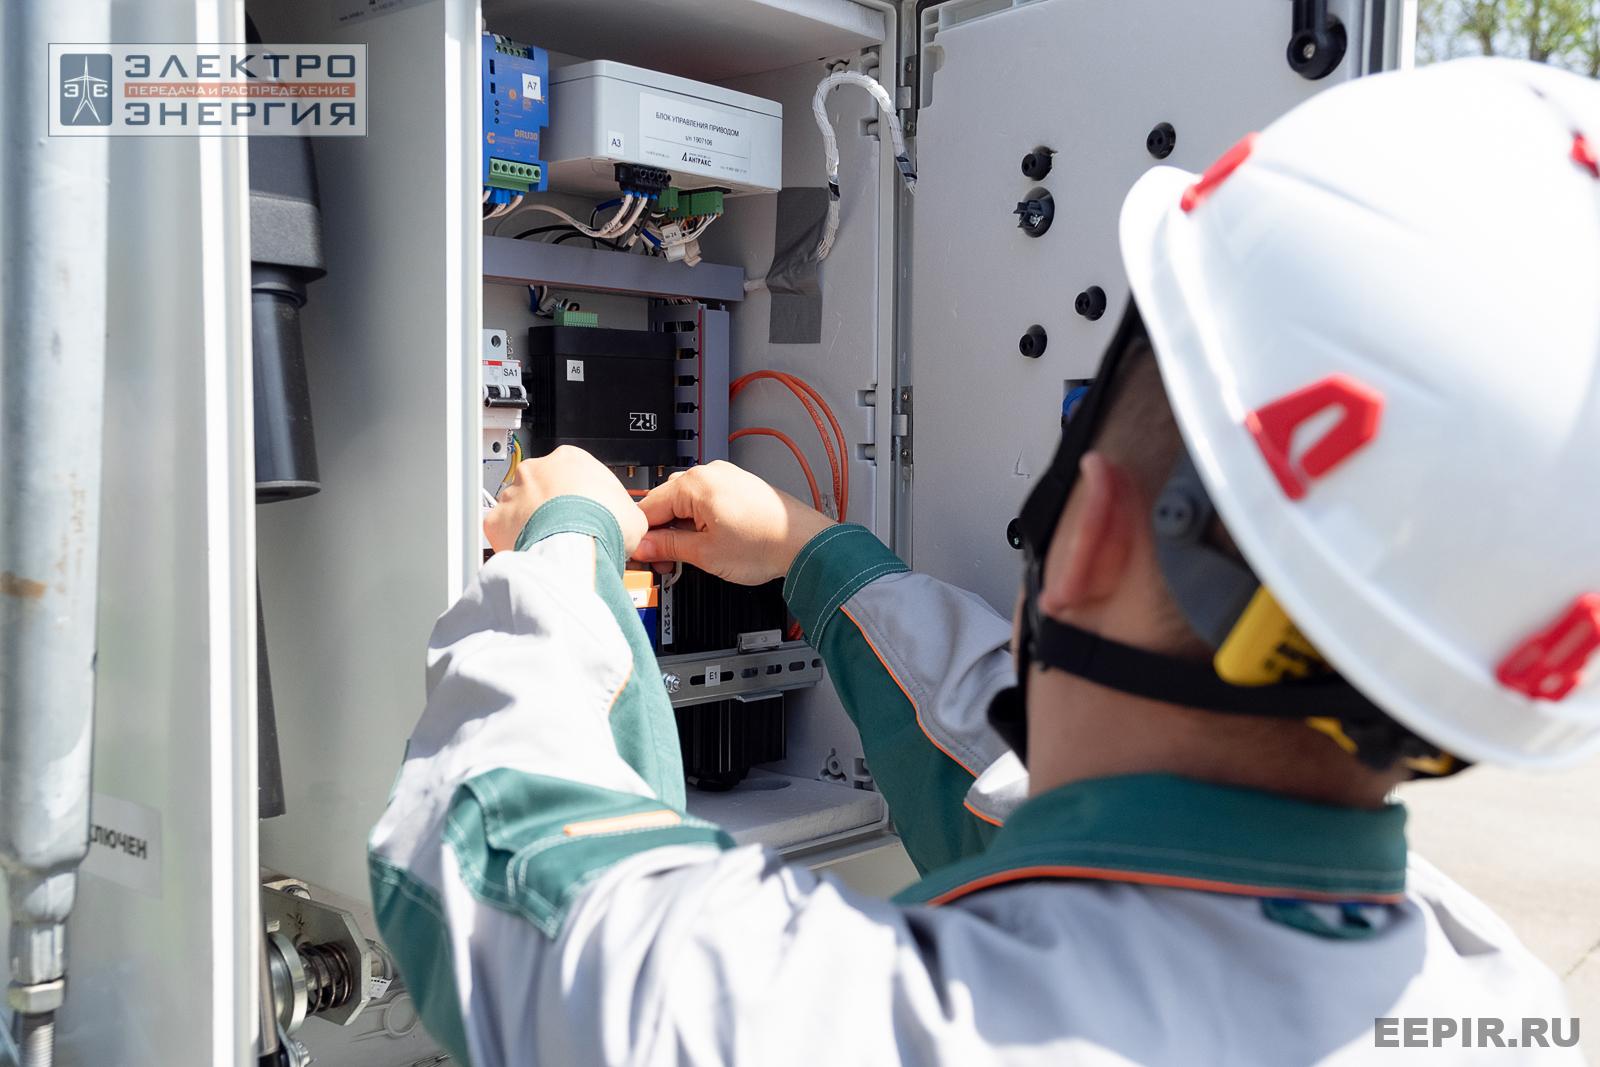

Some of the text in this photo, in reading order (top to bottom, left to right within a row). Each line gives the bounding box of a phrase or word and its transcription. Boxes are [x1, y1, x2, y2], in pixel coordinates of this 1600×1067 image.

[655, 111, 740, 137] БЛОК УПРАВЛЕНИЯ ПРИВОДОМ
[611, 138, 621, 148] A3
[688, 156, 712, 167] АНТРАКС
[503, 368, 518, 377] SA1
[571, 366, 581, 374] A6
[663, 604, 671, 636] +12V
[90, 824, 148, 860] ЛЮЧЕН
